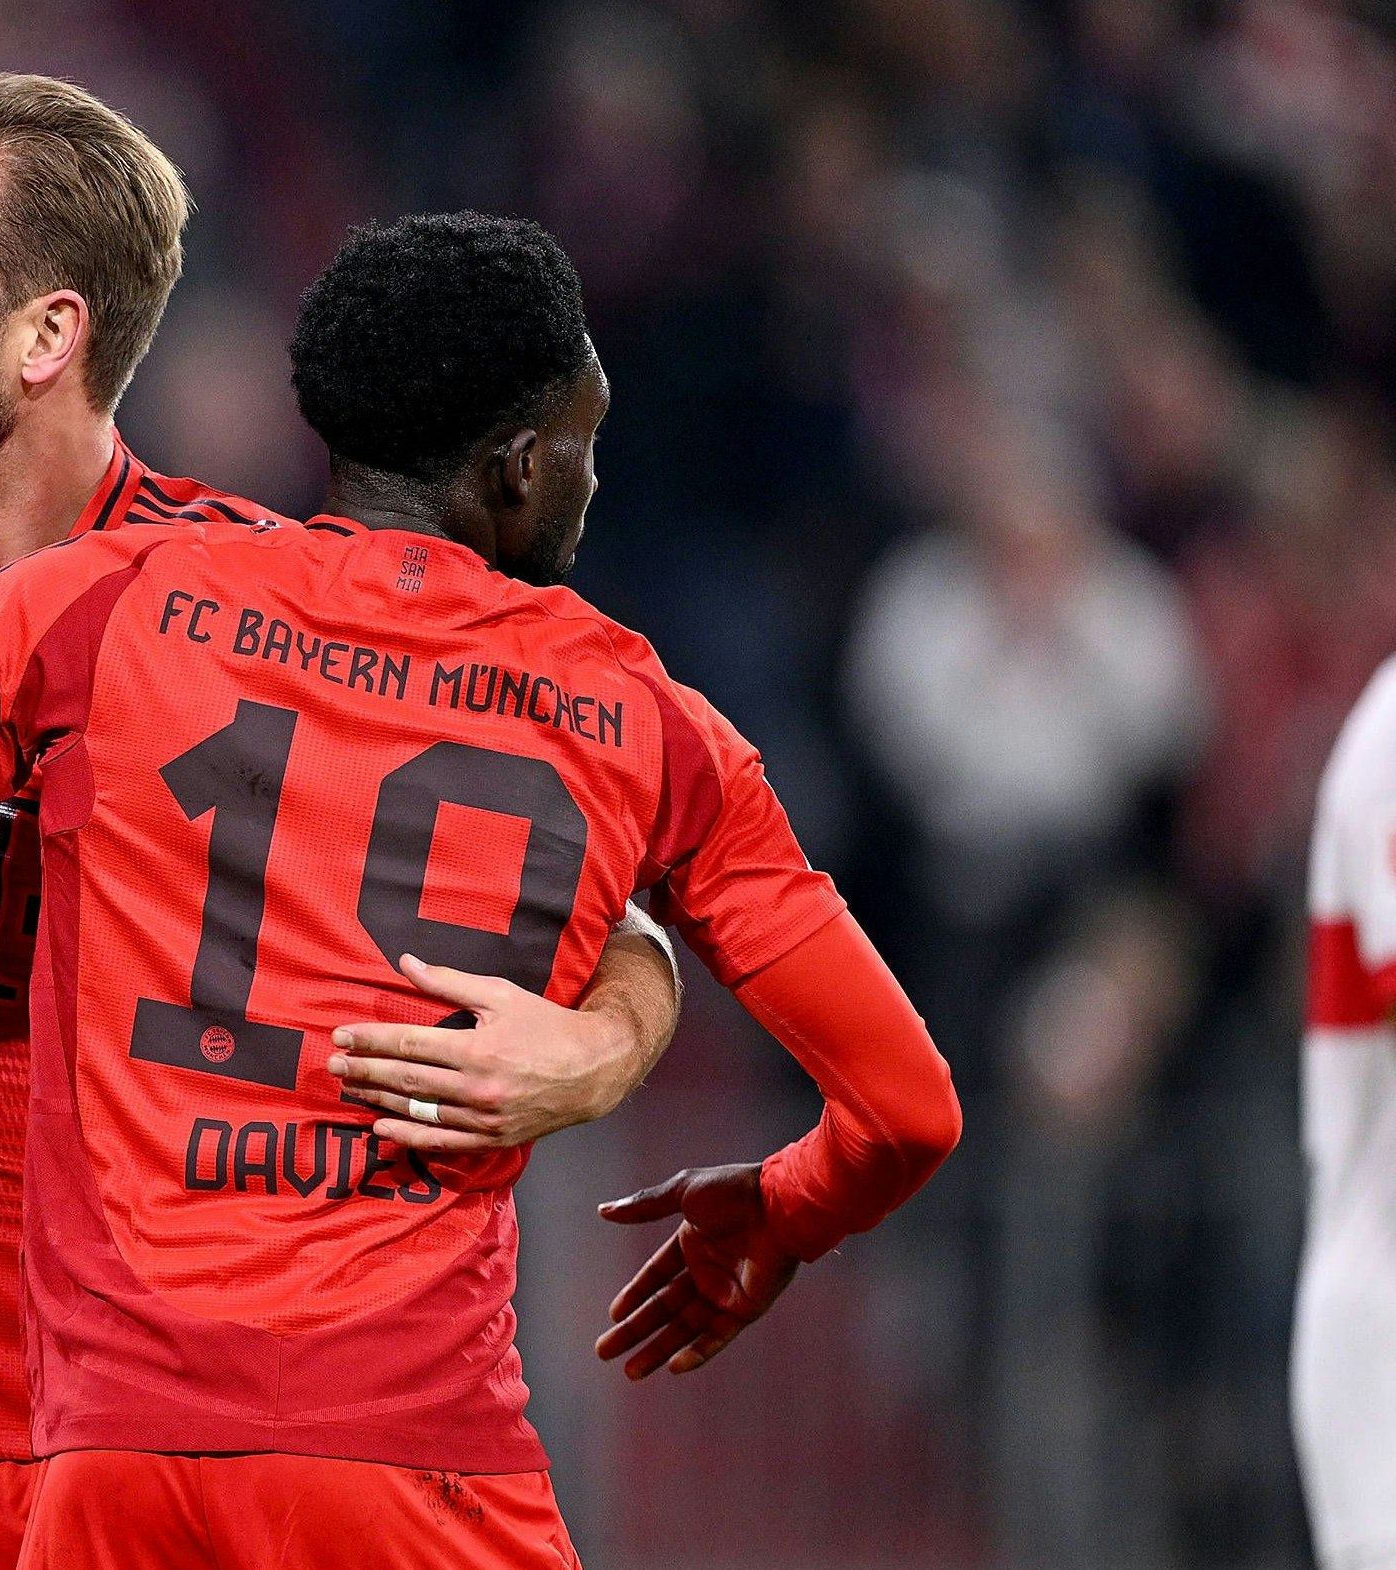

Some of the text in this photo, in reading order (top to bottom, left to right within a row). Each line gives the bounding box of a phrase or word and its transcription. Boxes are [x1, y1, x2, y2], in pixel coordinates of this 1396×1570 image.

[401, 560, 425, 578] SAN
[404, 546, 428, 562] MIA
[396, 576, 421, 593] MIA
[159, 590, 622, 747] FC BAYERN MÜNCHEN
[129, 698, 588, 1113] 19
[185, 1118, 441, 1204] DAVIES
